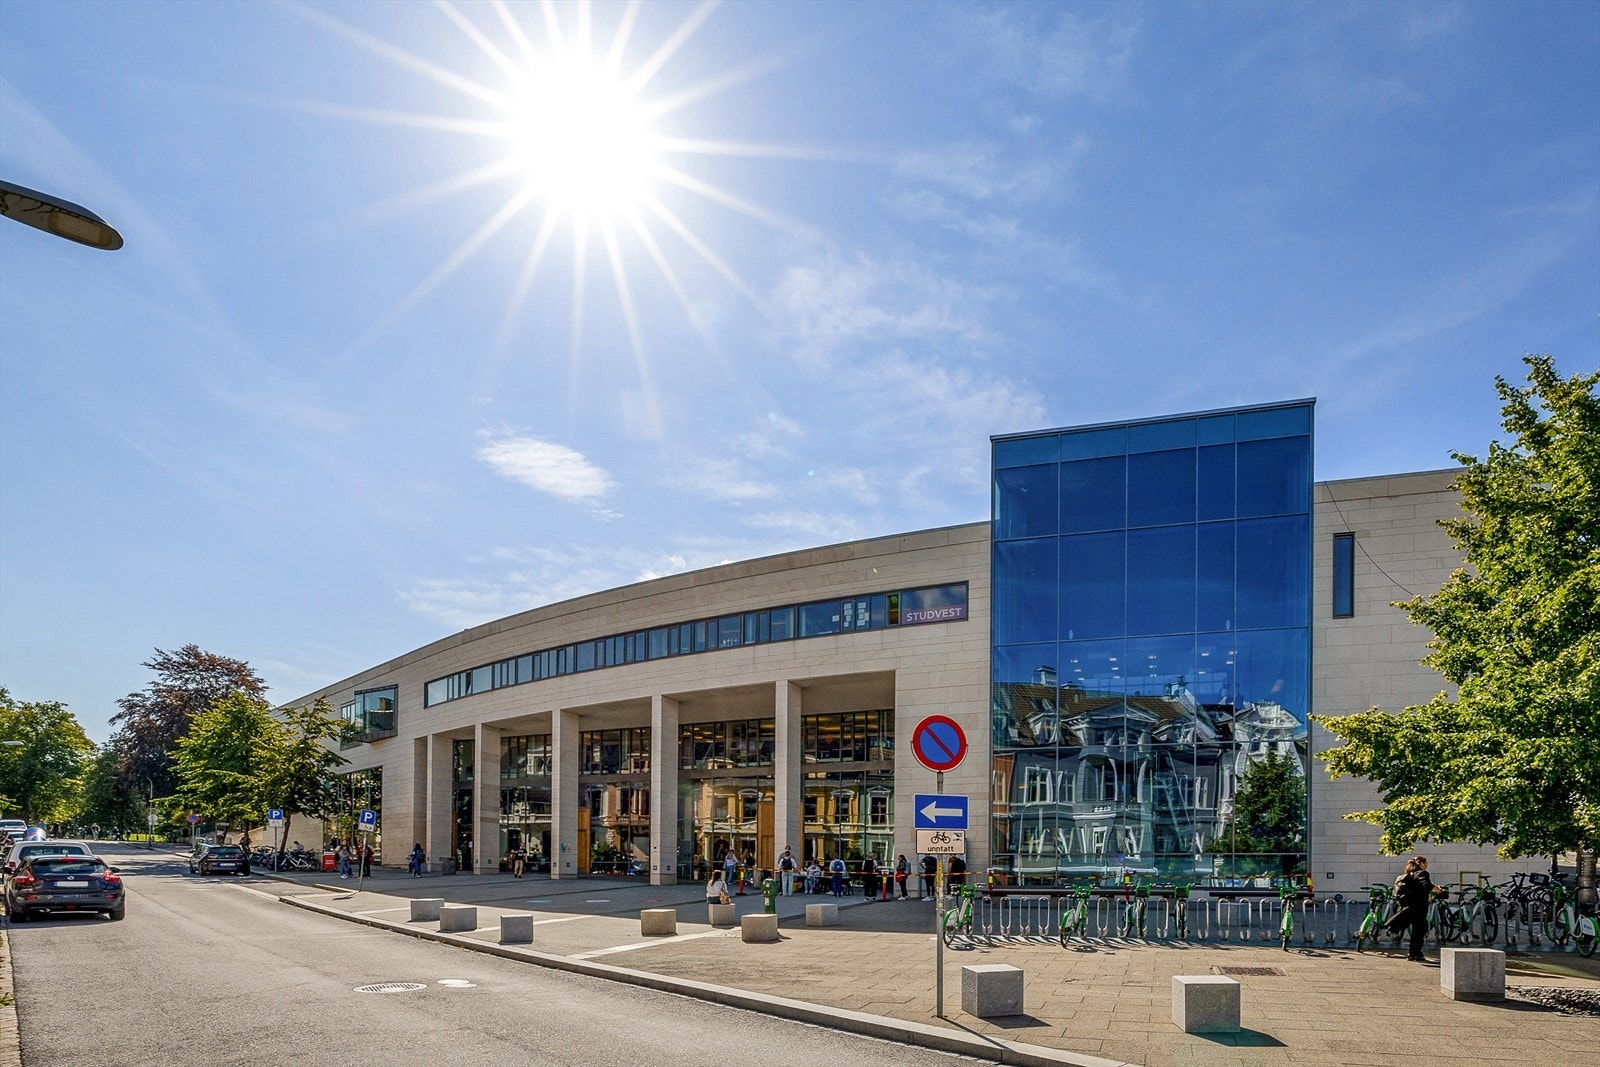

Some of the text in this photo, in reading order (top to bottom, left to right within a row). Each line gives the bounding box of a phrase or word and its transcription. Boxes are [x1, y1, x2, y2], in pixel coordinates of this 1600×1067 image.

[906, 607, 962, 622] STUDVEST
[272, 810, 280, 819] P
[364, 811, 373, 822] P
